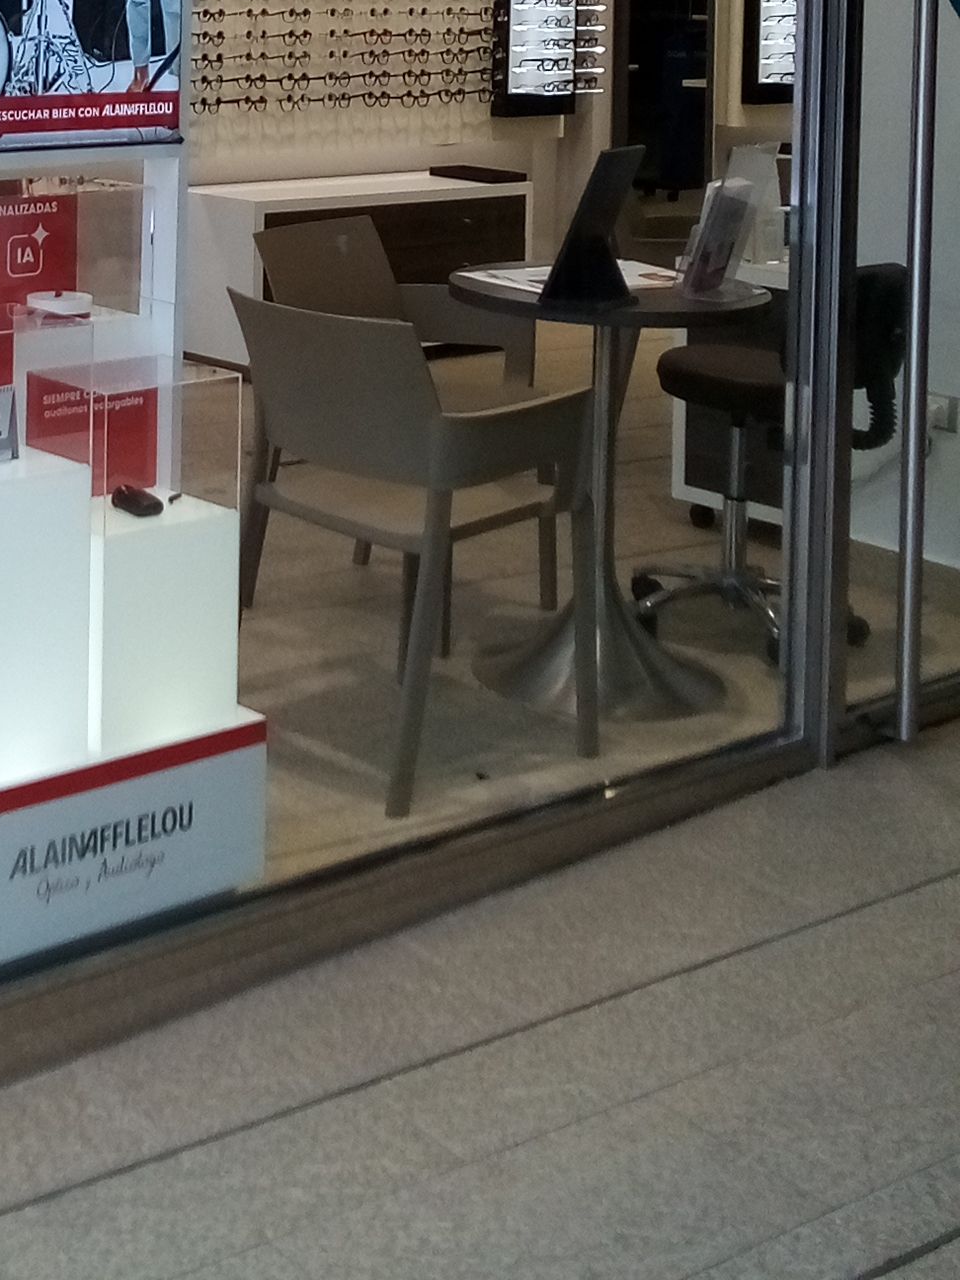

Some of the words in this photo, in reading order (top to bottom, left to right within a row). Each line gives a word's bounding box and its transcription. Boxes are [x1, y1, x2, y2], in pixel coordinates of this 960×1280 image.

[52, 107, 76, 118] BIEN
[78, 106, 100, 117] CON
[17, 247, 34, 264] IA
[43, 391, 81, 405] SIEMPRE
